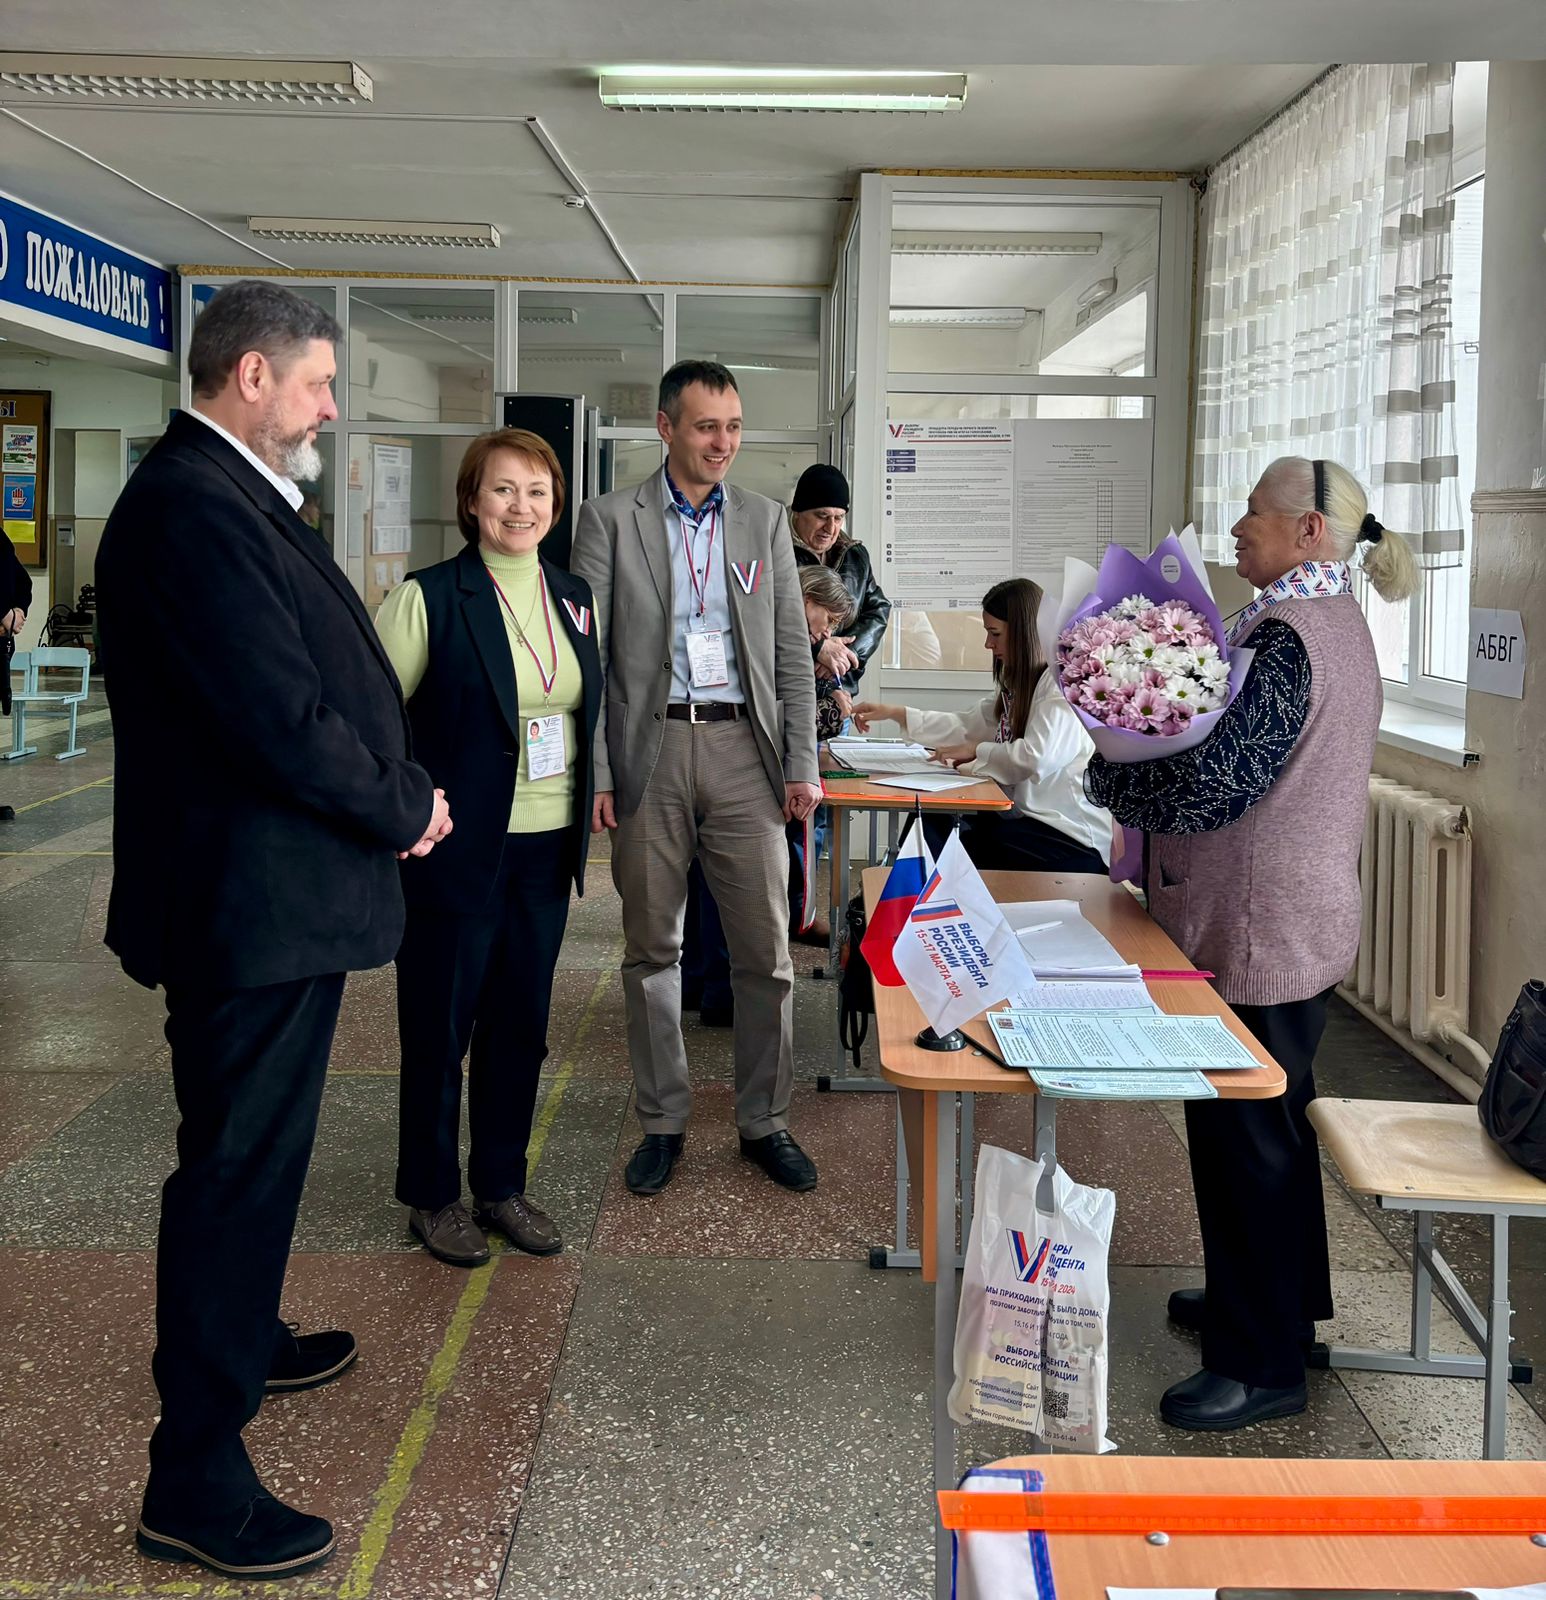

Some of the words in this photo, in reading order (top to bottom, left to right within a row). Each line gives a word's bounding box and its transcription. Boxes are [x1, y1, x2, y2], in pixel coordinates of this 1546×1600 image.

[26, 231, 149, 329] ПОЖАЛОВАТЬ
[1476, 633, 1518, 663] АБВГ
[928, 927, 961, 968] РОССИИ
[943, 925, 989, 989] ПРЕЗИДЕНТА
[958, 922, 994, 968] ВЫБОРЫ
[929, 953, 952, 980] МАРТА
[946, 979, 964, 999] 2024
[986, 1286, 999, 1295] МЫ
[1057, 1306, 1078, 1315] БЫЛО
[990, 1300, 1016, 1311] ПОЭТОМУ
[1058, 1284, 1076, 1295] 2024
